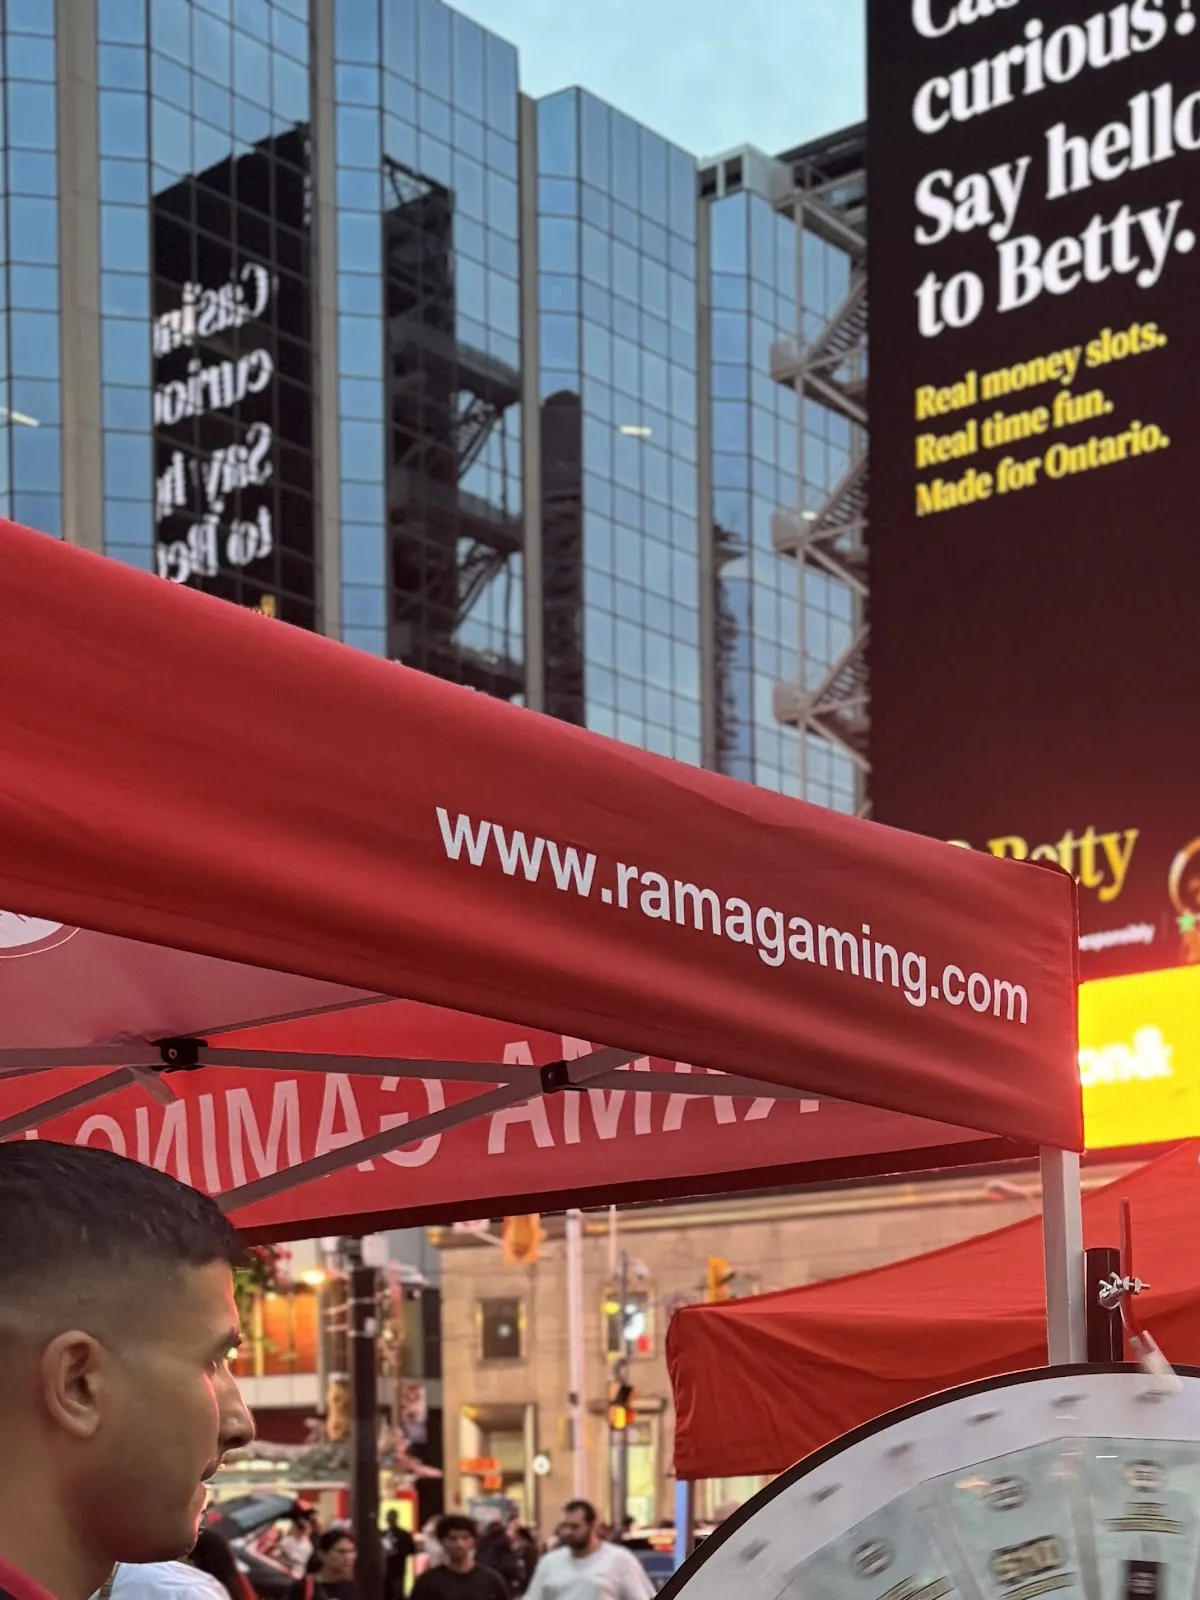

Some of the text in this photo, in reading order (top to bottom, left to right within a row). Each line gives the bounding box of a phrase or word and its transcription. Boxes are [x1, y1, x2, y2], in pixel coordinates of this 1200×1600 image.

[915, 169, 1032, 246] Say
[914, 199, 1196, 338] to Betty.
[915, 321, 1168, 421] Real money slots.
[915, 389, 1114, 469] Real time fun.
[915, 419, 1171, 517] Made for Ontario.
[435, 805, 1030, 1026] www.ramagaming.com
